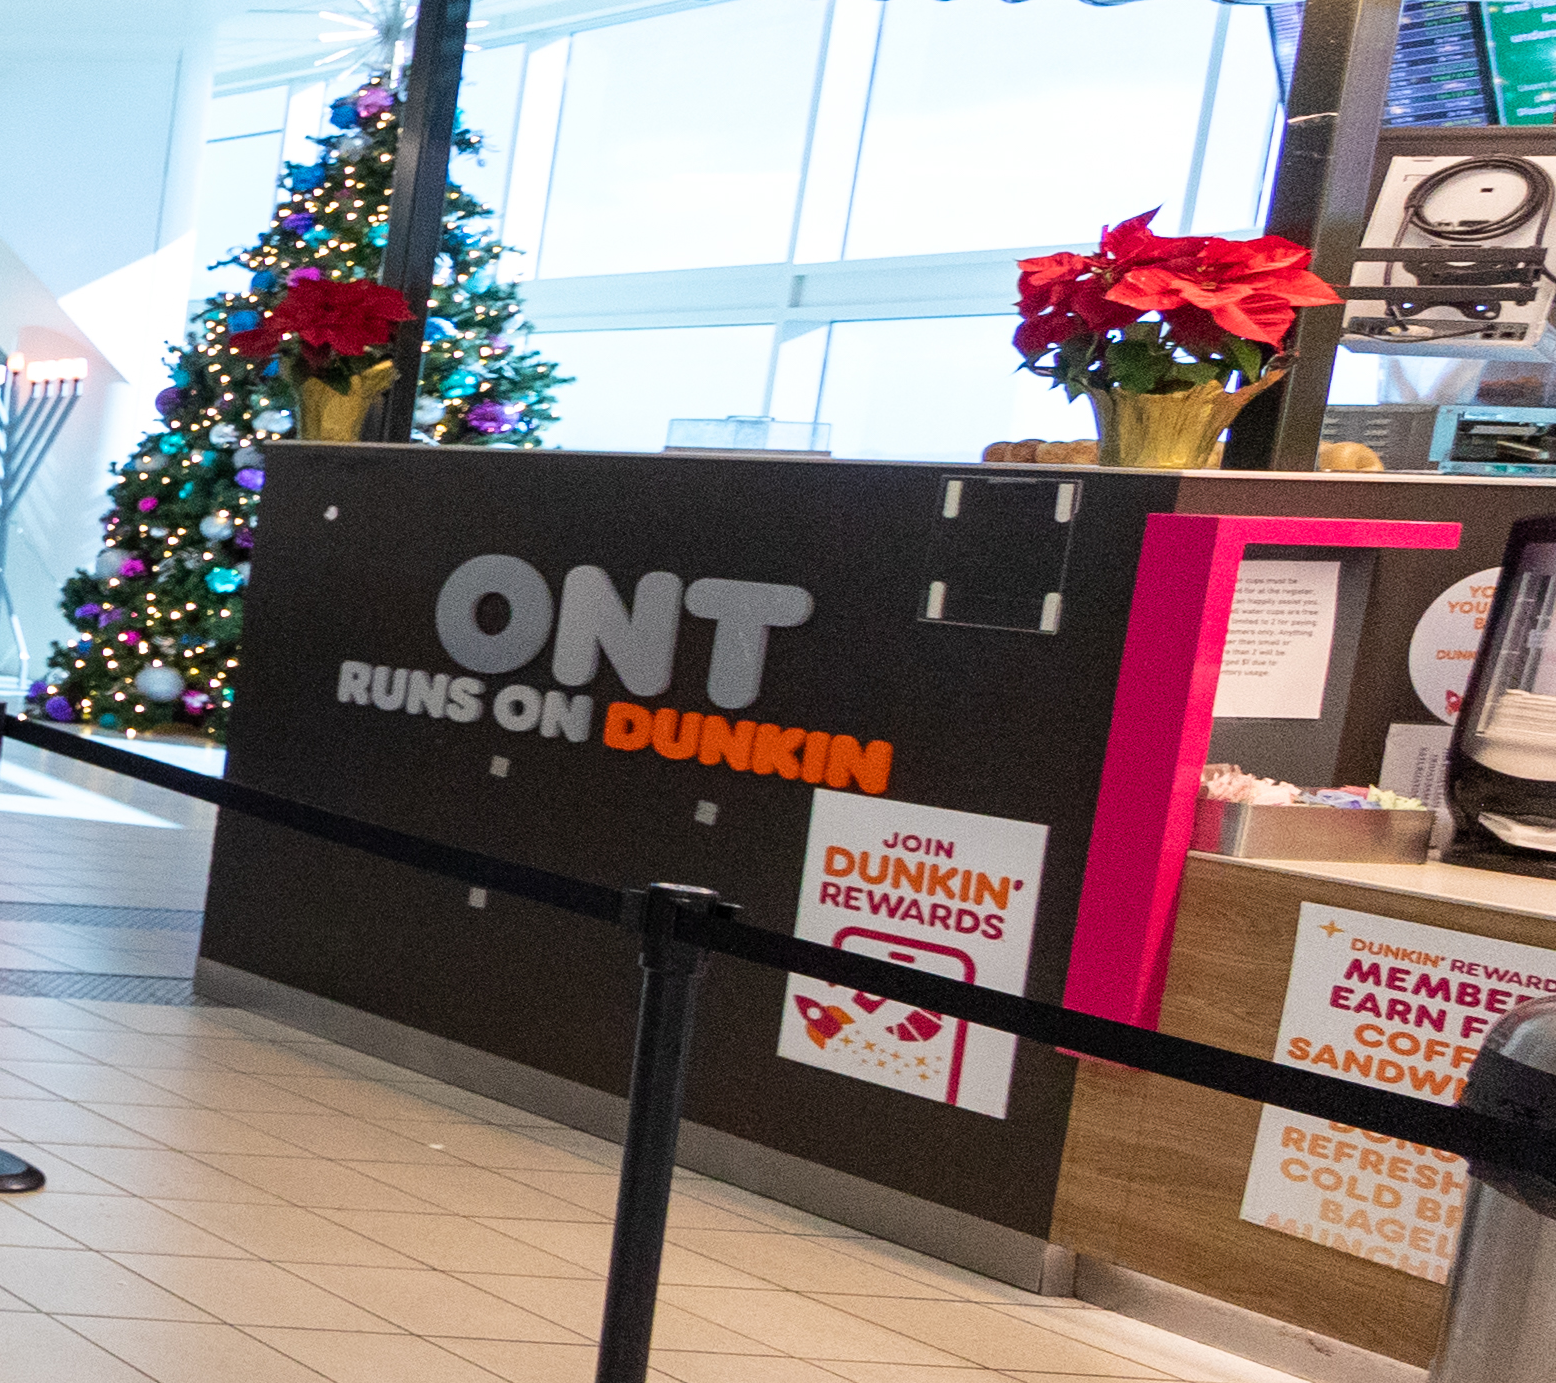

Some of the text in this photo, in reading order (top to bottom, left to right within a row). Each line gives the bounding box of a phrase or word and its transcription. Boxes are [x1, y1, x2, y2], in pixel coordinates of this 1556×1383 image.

[436, 554, 813, 709] ONT
[337, 661, 893, 794] RUNS ON DUNKIN
[883, 832, 954, 859] JOIN
[819, 846, 1024, 911] DUNKIN'
[820, 882, 1004, 940] REWARDS
[1351, 938, 1446, 968] DUNKIN'
[1330, 985, 1447, 1033] EARN
[1354, 1023, 1480, 1069] COFF
[1280, 1157, 1402, 1209] COLD
